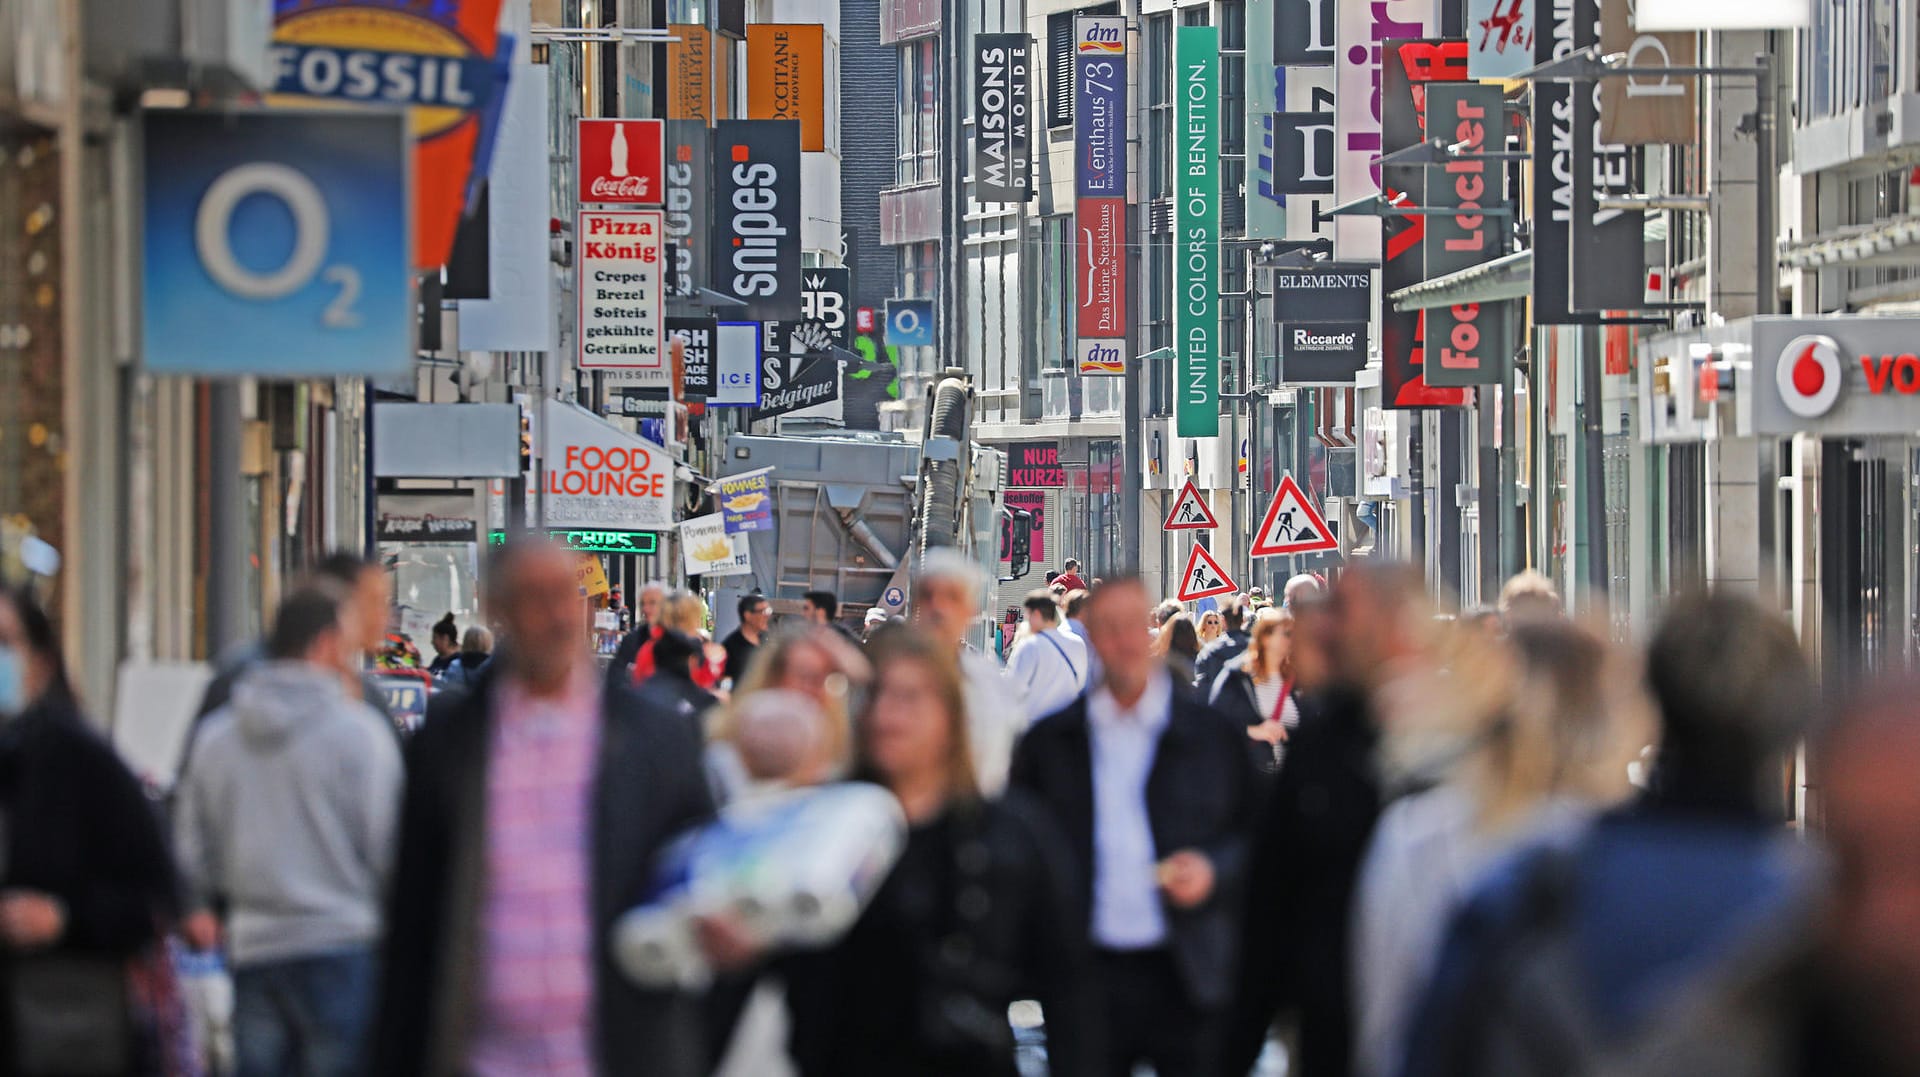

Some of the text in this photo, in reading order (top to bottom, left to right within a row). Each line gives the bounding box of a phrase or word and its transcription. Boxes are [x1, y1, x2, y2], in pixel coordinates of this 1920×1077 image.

[1086, 22, 1119, 41] dm
[277, 46, 473, 104] FOSSIL
[982, 47, 1005, 187] MAISONS
[1013, 48, 1026, 188] DU MONDE
[1085, 62, 1113, 189] Eventhaus 73
[1445, 99, 1485, 251] Locker
[1189, 187, 1207, 217] OF
[590, 218, 652, 236] Pizza
[732, 163, 787, 297] snipes
[584, 242, 657, 264] König
[595, 271, 647, 283] Crepes
[1098, 204, 1111, 331] Das kleine Steakhaus
[1189, 228, 1207, 316] COLORS
[1279, 274, 1369, 289] ELEMENTS
[597, 289, 645, 300] Brezel
[593, 307, 647, 319] Softeis
[586, 325, 655, 339] gekühlte
[1294, 330, 1355, 345] Riccardo
[584, 343, 657, 355] Getränke
[1087, 343, 1119, 361] dm
[1189, 327, 1207, 404] UNITED
[760, 379, 833, 412] Belgique
[565, 446, 651, 473] FOOD
[1023, 448, 1058, 465] NUR
[551, 470, 664, 498] LOUNGE
[1012, 468, 1063, 486] KURZE
